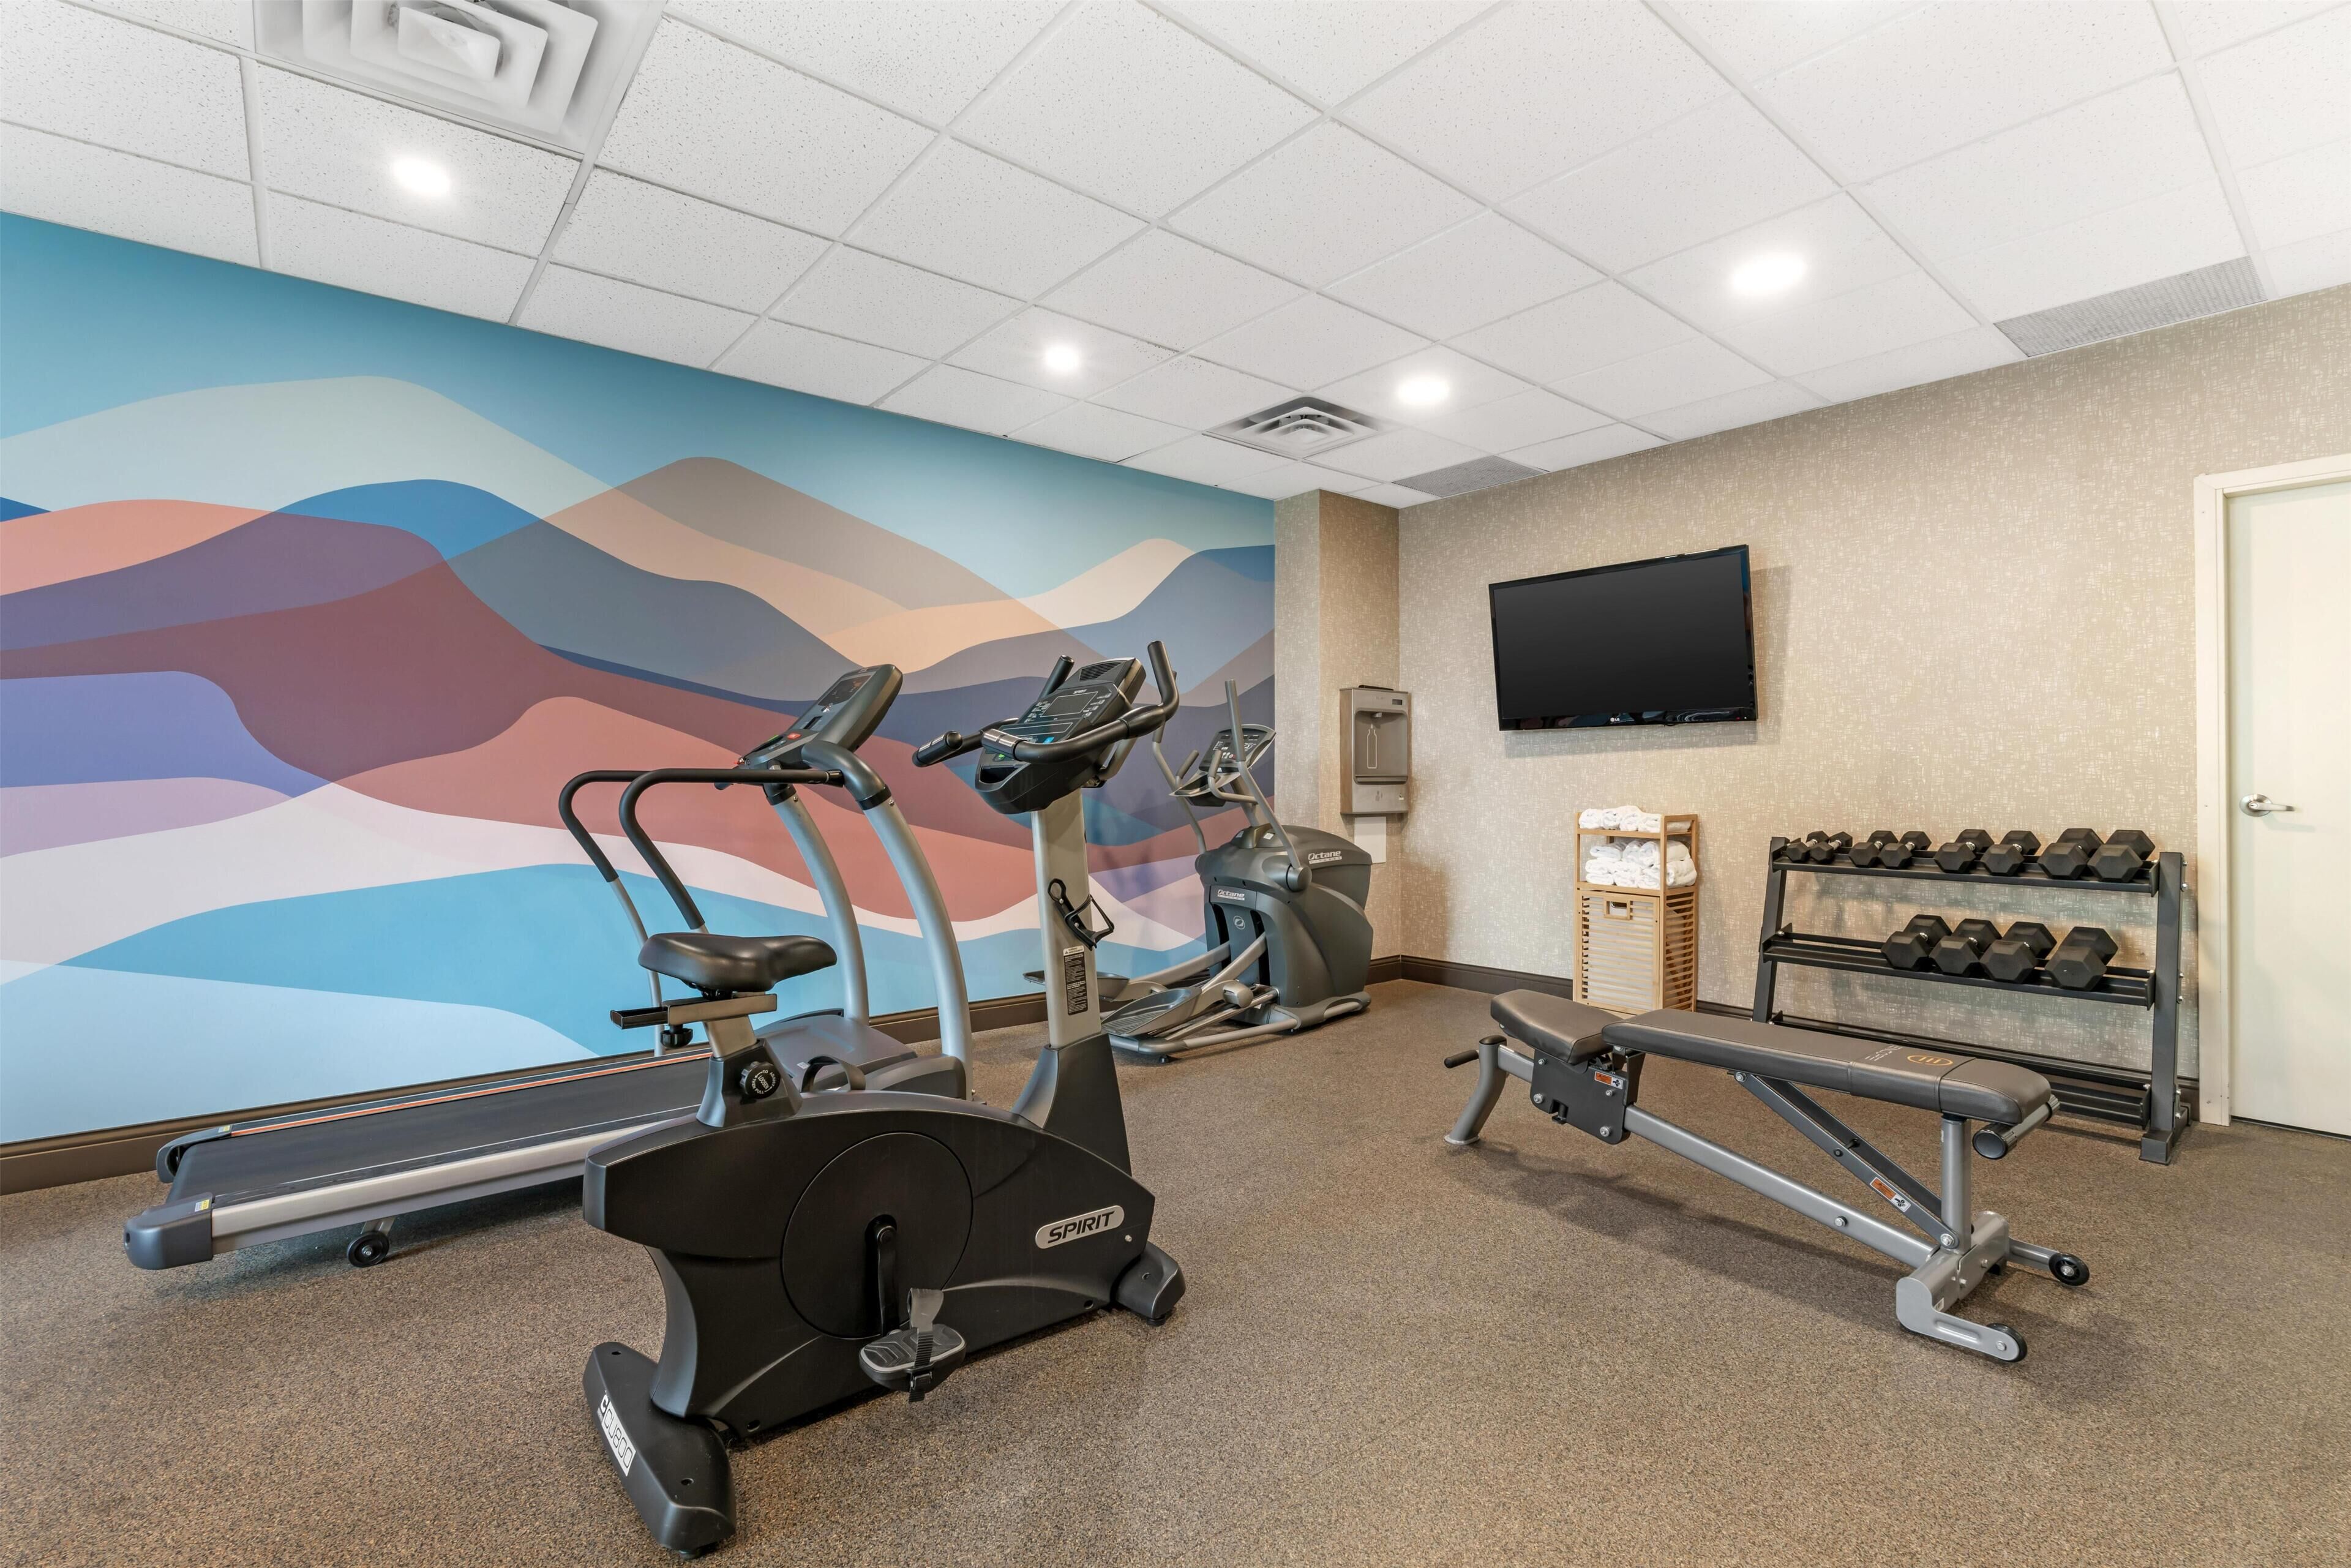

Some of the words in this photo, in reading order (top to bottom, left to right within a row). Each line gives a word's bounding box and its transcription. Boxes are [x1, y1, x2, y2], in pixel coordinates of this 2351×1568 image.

[1308, 850, 1341, 860] Octane
[1217, 889, 1245, 898] Octane
[757, 1075, 770, 1089] LOOSEN
[1048, 1210, 1115, 1244] SPIRIT
[604, 1408, 634, 1469] CU800
